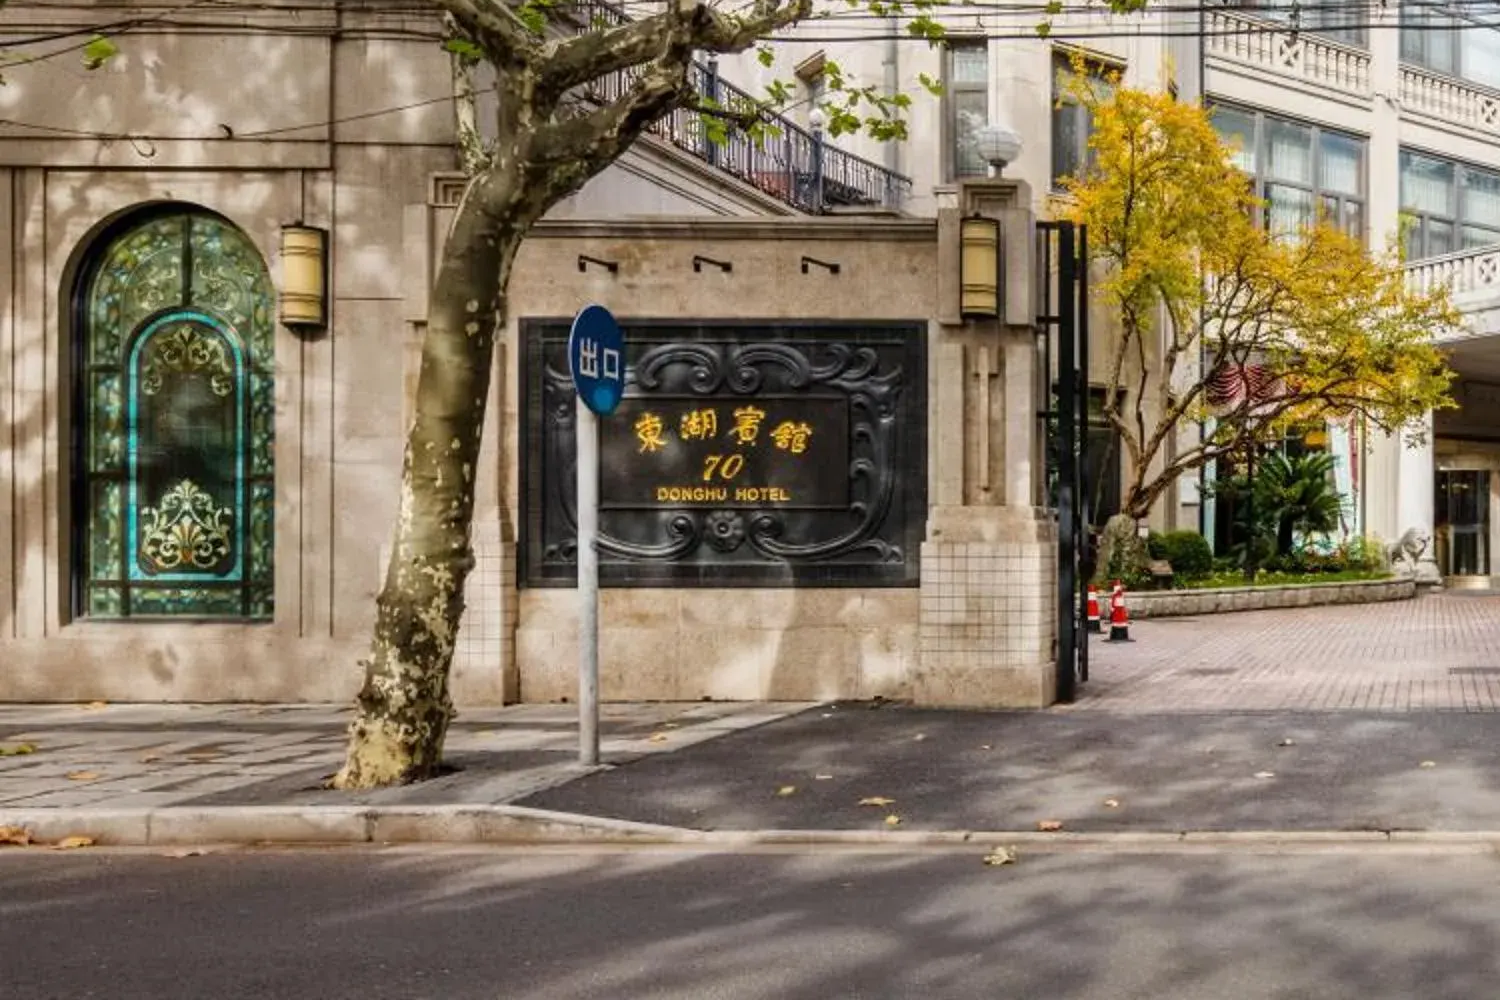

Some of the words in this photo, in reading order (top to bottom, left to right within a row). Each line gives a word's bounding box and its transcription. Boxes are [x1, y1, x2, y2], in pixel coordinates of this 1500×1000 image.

[579, 337, 620, 380] 出口
[703, 454, 744, 481] 70
[657, 487, 728, 501] DONGHU
[735, 487, 790, 501] HOTEL
